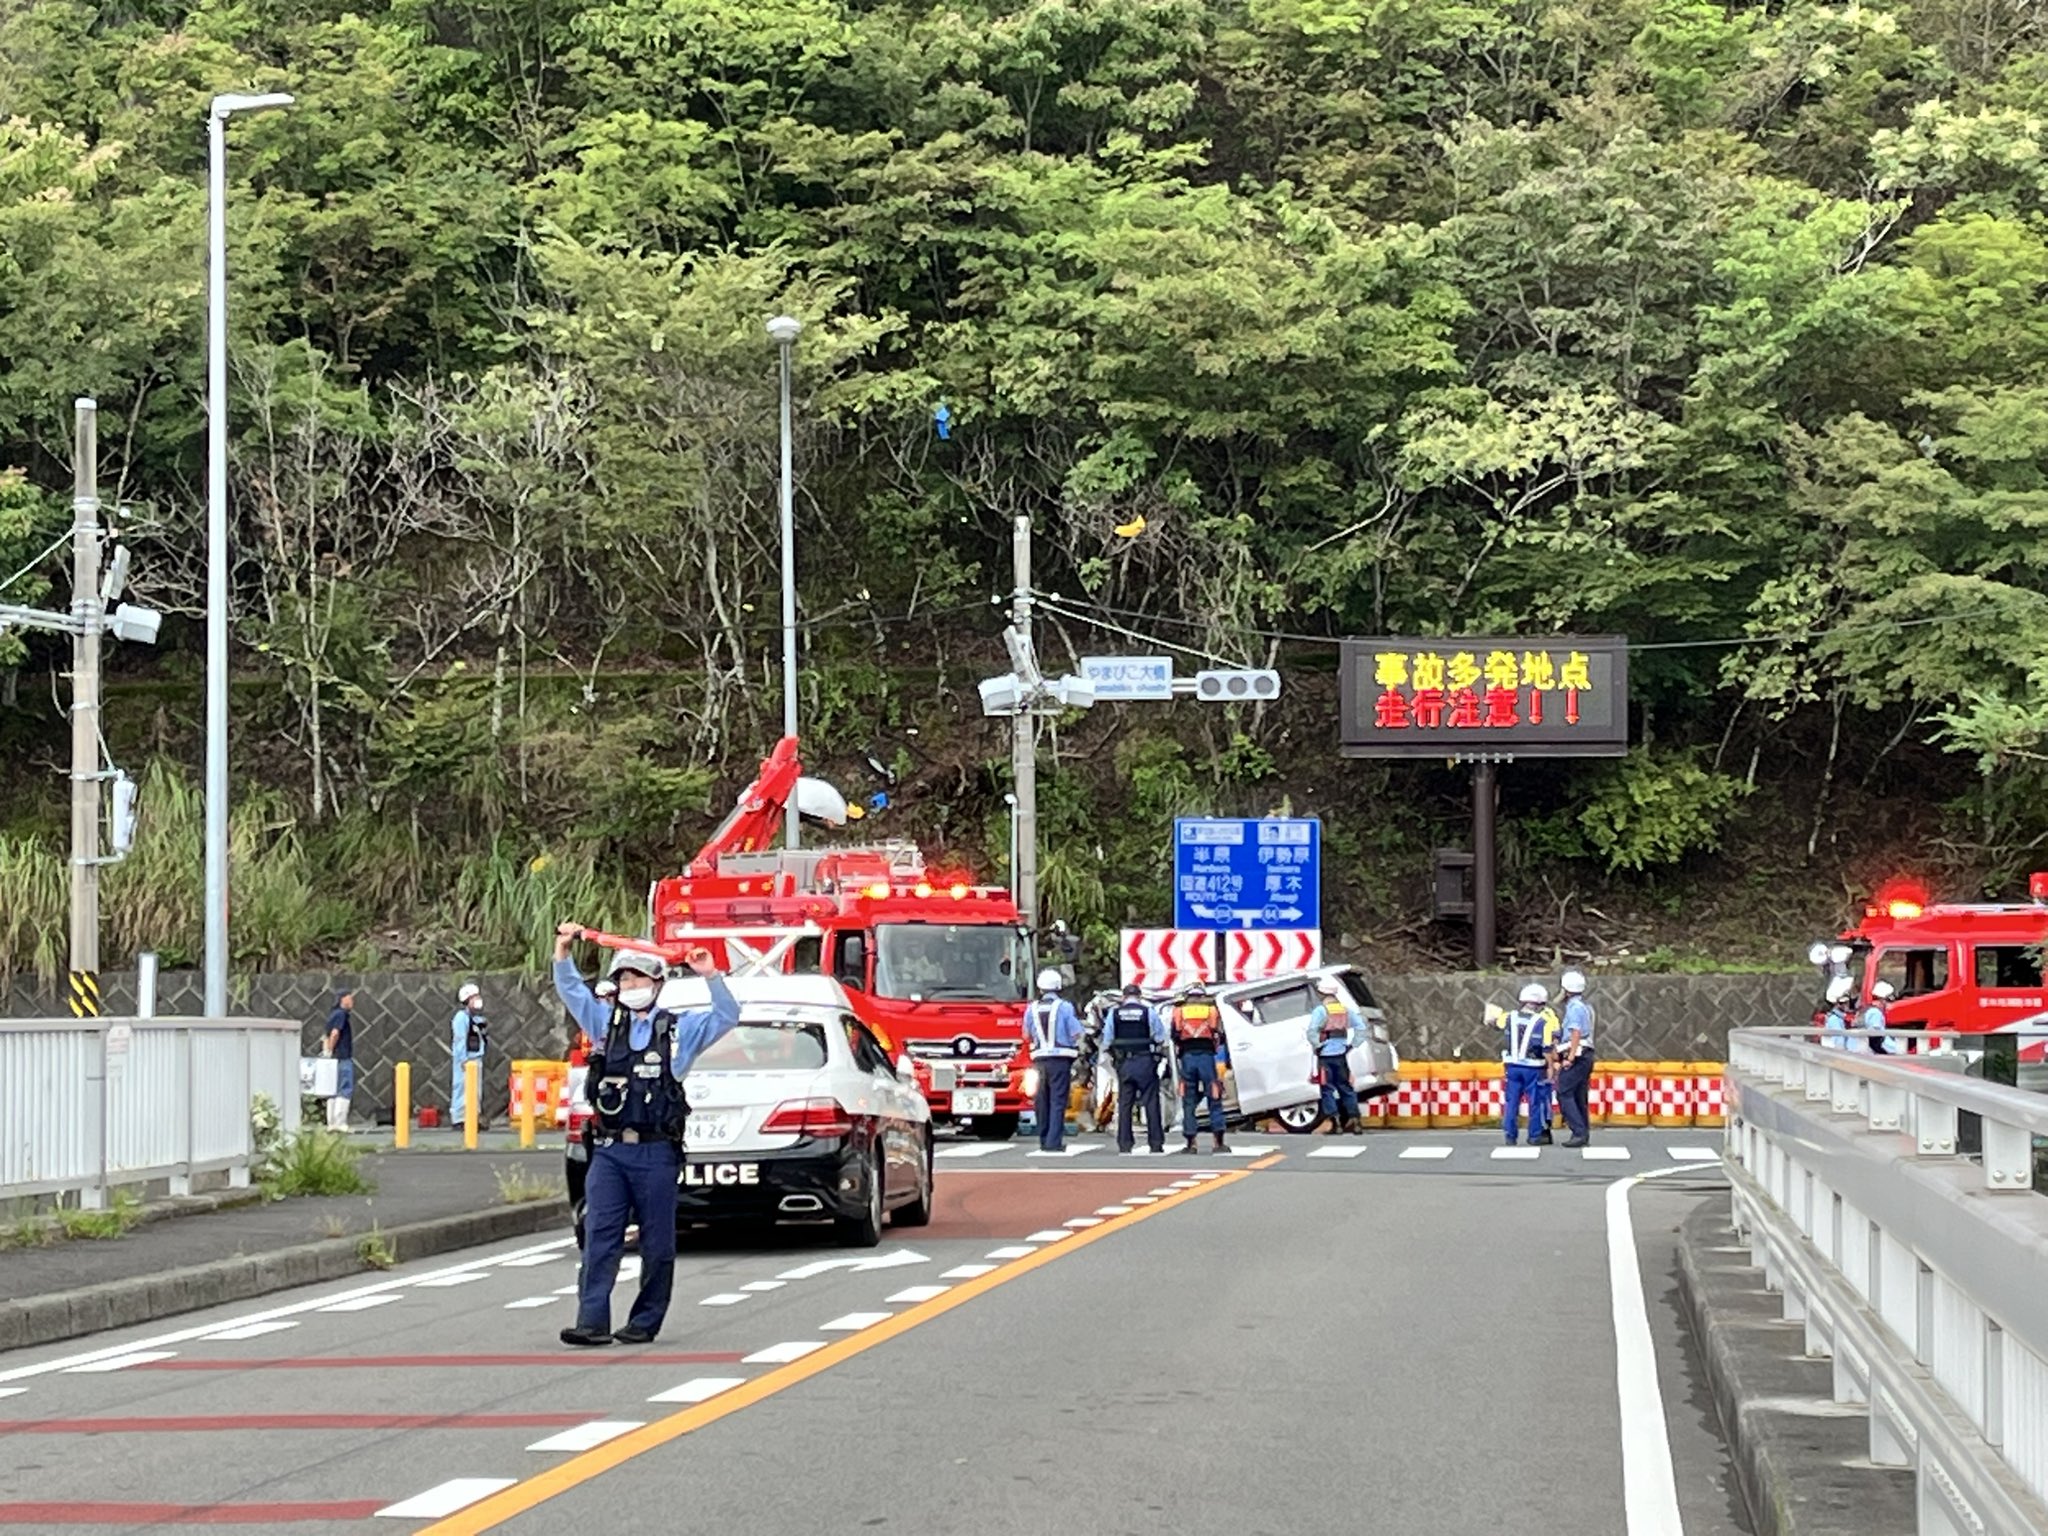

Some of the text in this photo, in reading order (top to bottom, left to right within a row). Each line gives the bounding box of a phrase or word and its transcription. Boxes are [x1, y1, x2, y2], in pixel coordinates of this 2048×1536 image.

[1374, 651, 1592, 690] 事故多発地点
[677, 1163, 760, 1185] LICE
